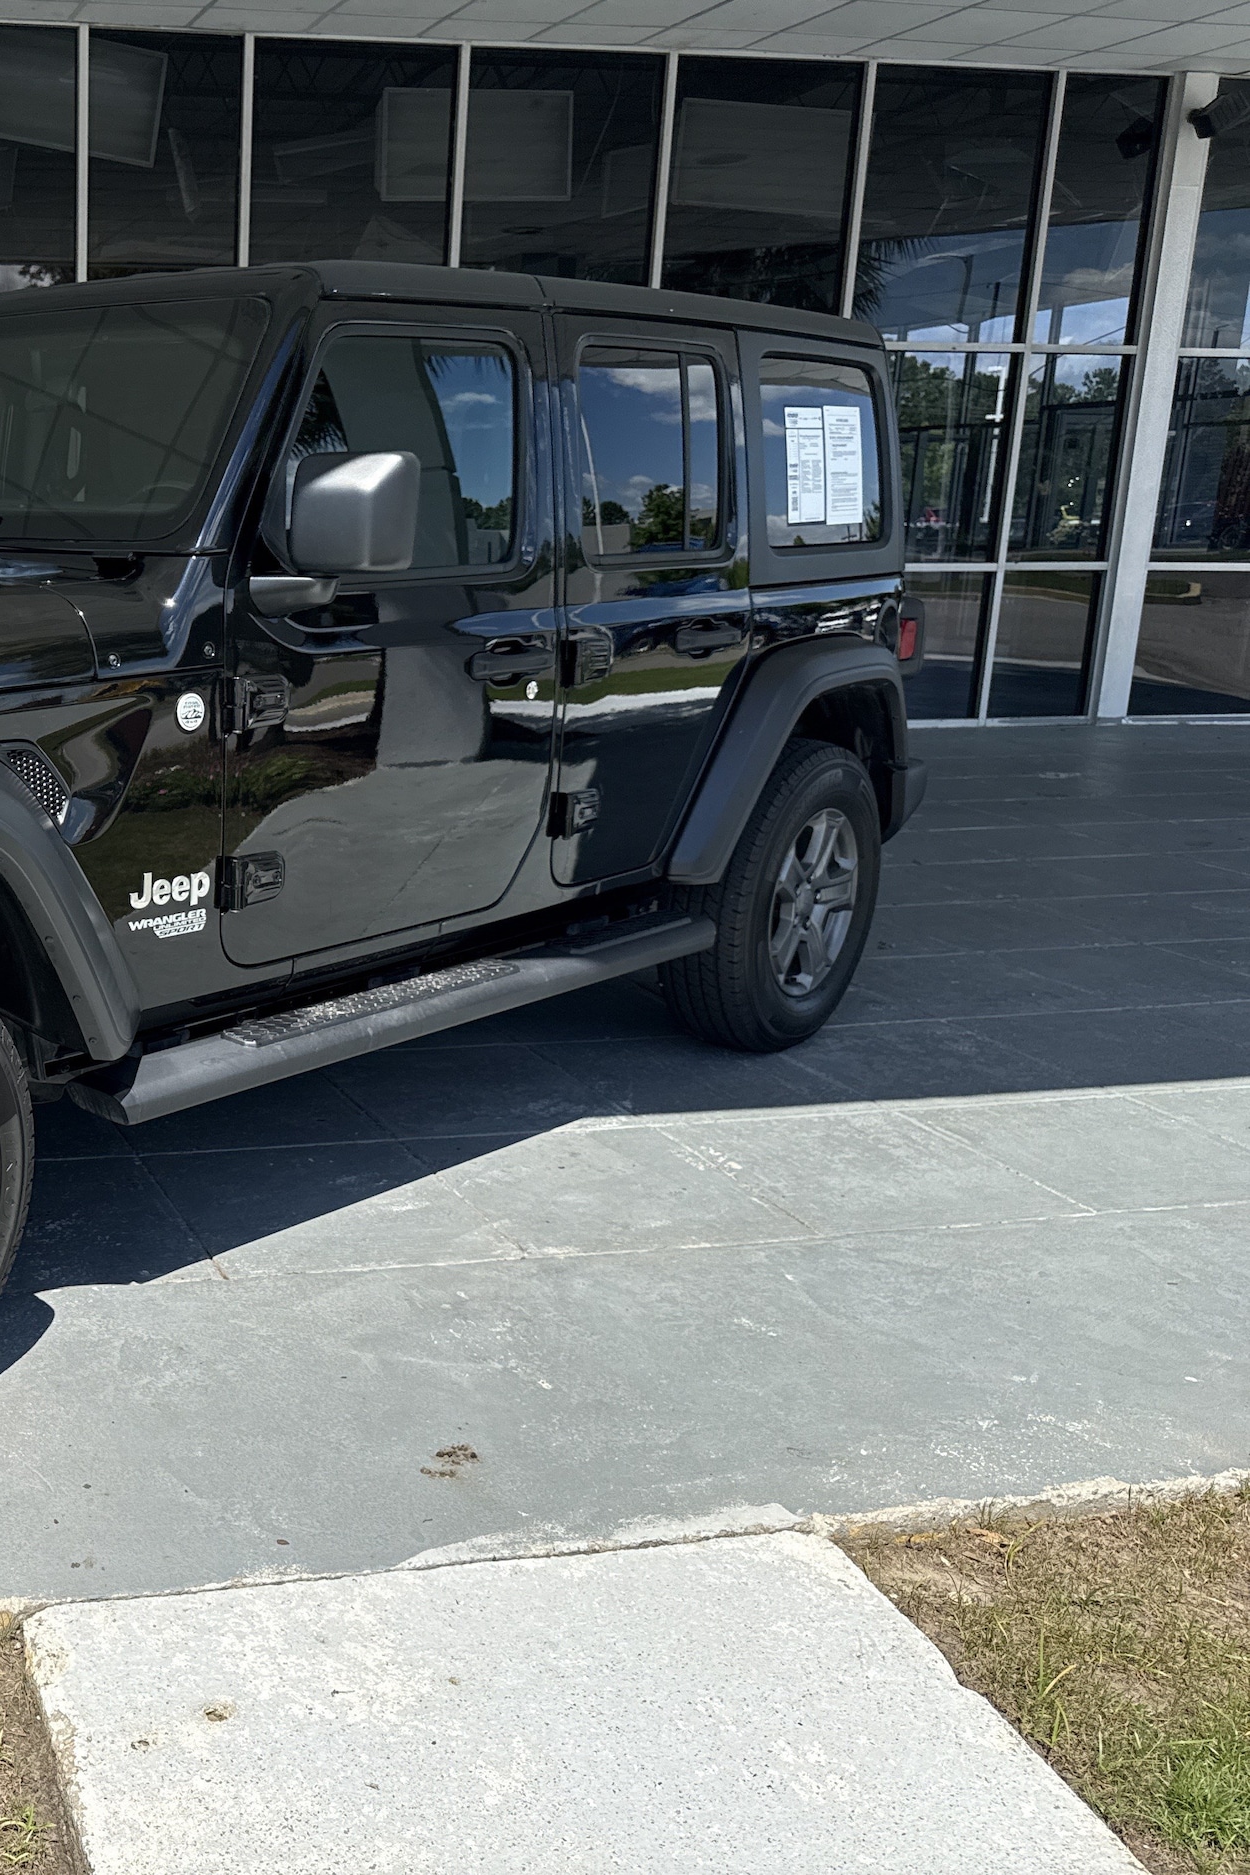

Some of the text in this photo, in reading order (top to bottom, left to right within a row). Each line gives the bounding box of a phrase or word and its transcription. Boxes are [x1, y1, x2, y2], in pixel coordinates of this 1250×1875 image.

[129, 871, 210, 909] Jeep
[128, 908, 207, 932] WRANGLER
[153, 916, 207, 931] UNLIMITED
[158, 922, 205, 937] SPORT
